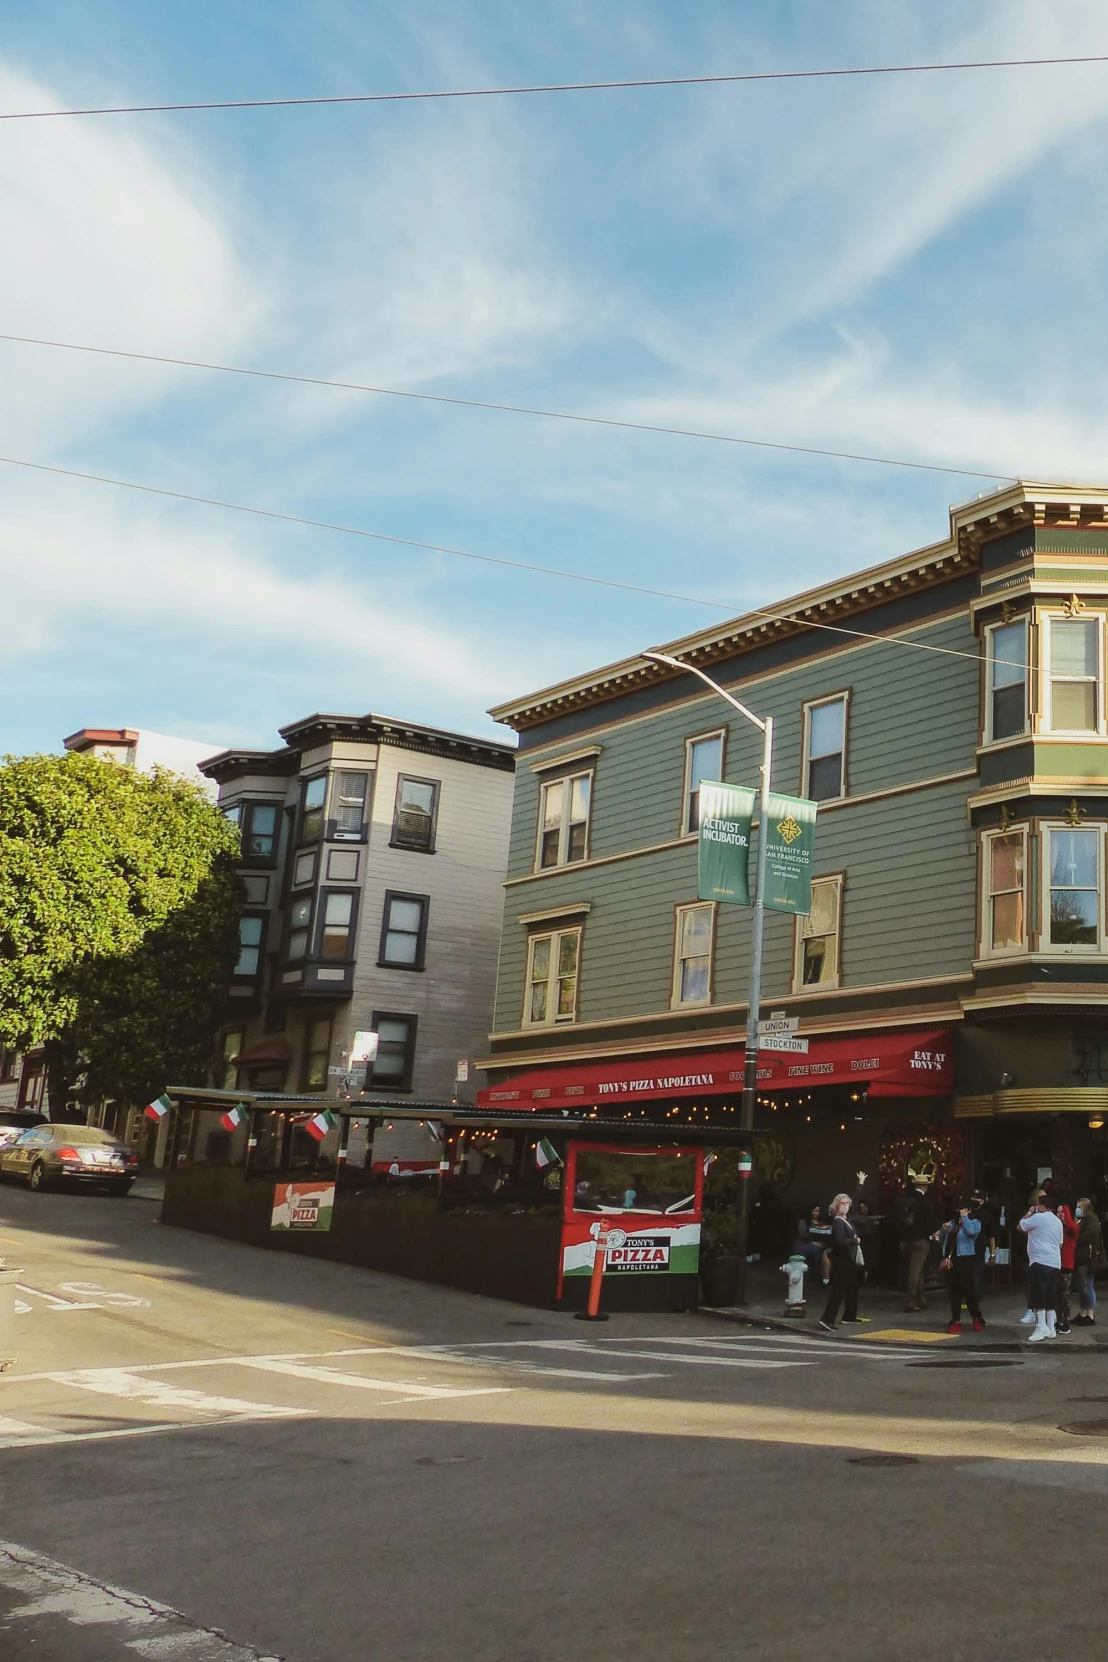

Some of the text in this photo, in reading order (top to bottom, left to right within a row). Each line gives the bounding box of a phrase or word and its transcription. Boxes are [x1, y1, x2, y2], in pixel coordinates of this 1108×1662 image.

[703, 818, 740, 834] ACTIVIST
[703, 829, 749, 847] INCUBATOR.
[777, 853, 810, 864] FRANCISCO
[765, 1021, 790, 1031] UNION
[764, 1039, 803, 1050] STOCKTON
[914, 1051, 946, 1062] EAT AT
[909, 1060, 942, 1071] TONY'S
[598, 1082, 628, 1094] TONY'S
[629, 1079, 654, 1091] PIZZA
[657, 1074, 714, 1089] NAPOLETANA
[789, 1065, 809, 1076] FINE
[810, 1063, 834, 1075] WINE
[851, 1058, 880, 1070] DOLCI
[293, 1210, 316, 1220] PIZZA
[611, 1249, 665, 1262] PIZZA
